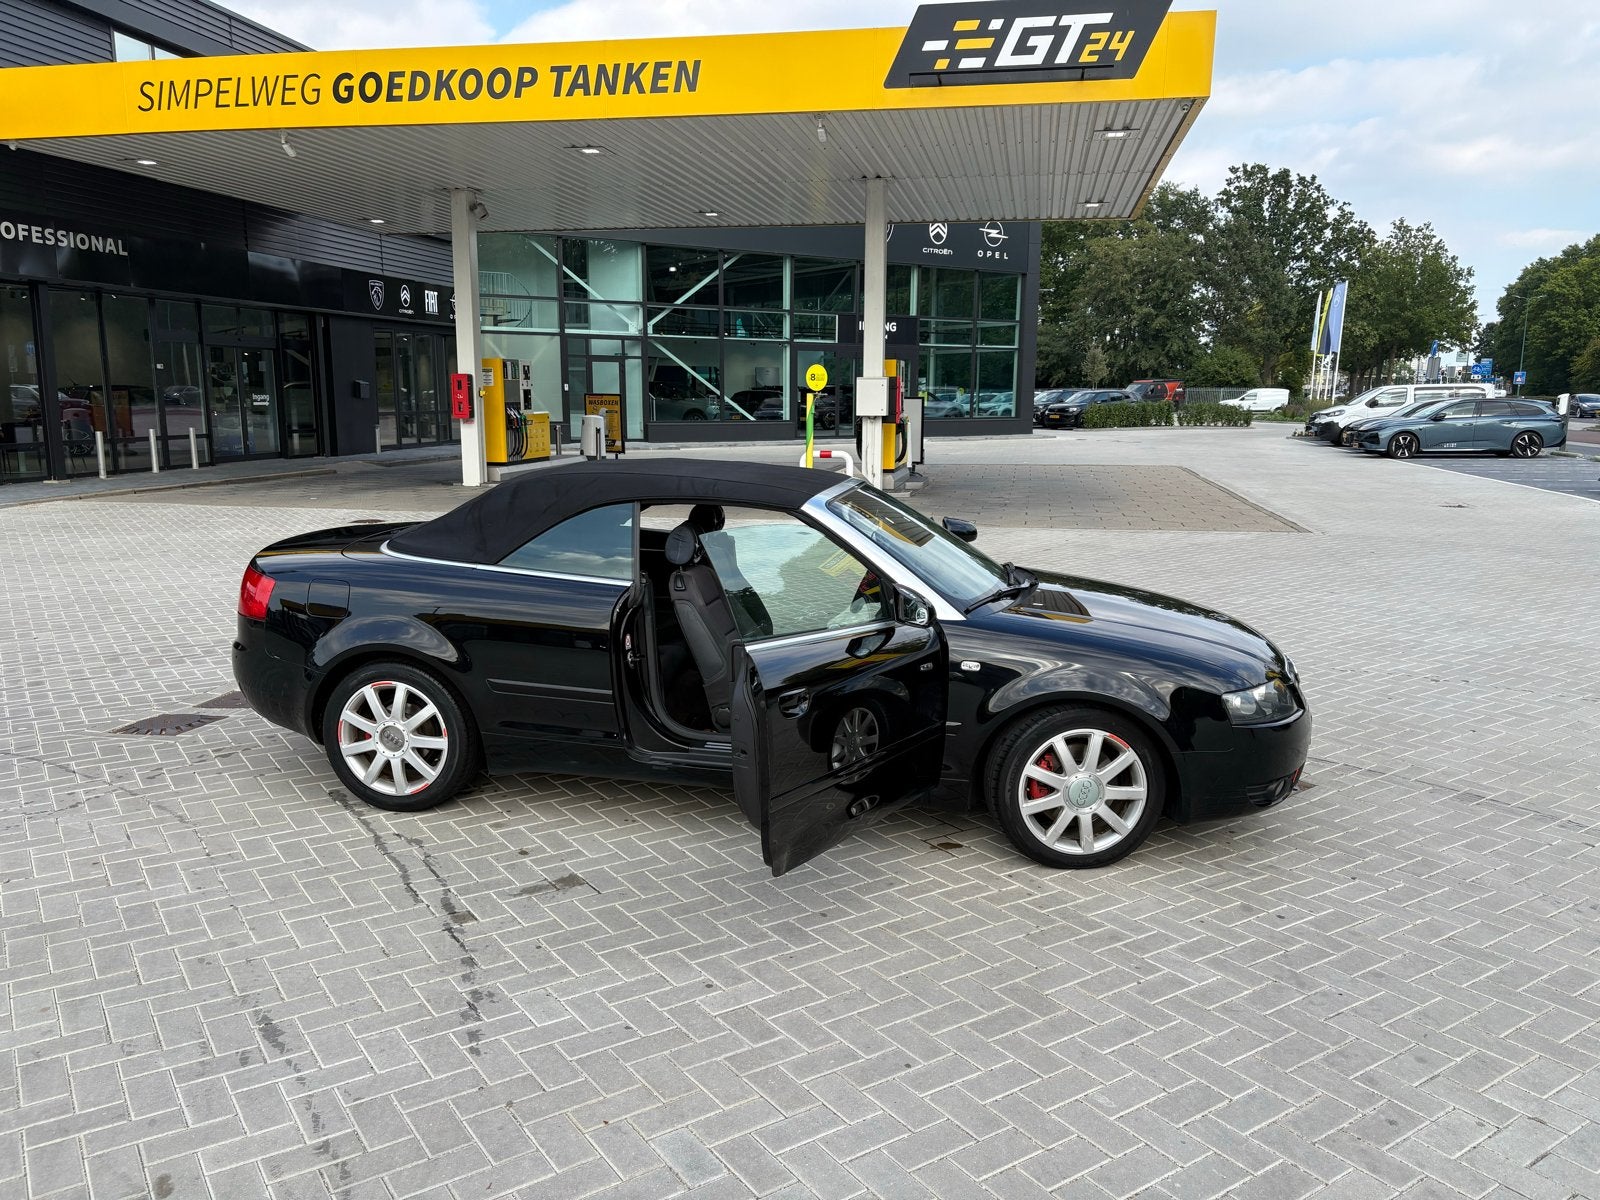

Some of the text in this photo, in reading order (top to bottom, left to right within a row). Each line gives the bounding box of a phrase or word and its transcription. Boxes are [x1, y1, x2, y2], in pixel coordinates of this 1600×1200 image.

[138, 59, 702, 111] SIMPELWEG GOEDKOOP TANKEN
[0, 221, 128, 256] OFESSIONAL
[977, 250, 1008, 259] OPEL
[424, 290, 438, 313] FIAT
[810, 373, 816, 381] 8
